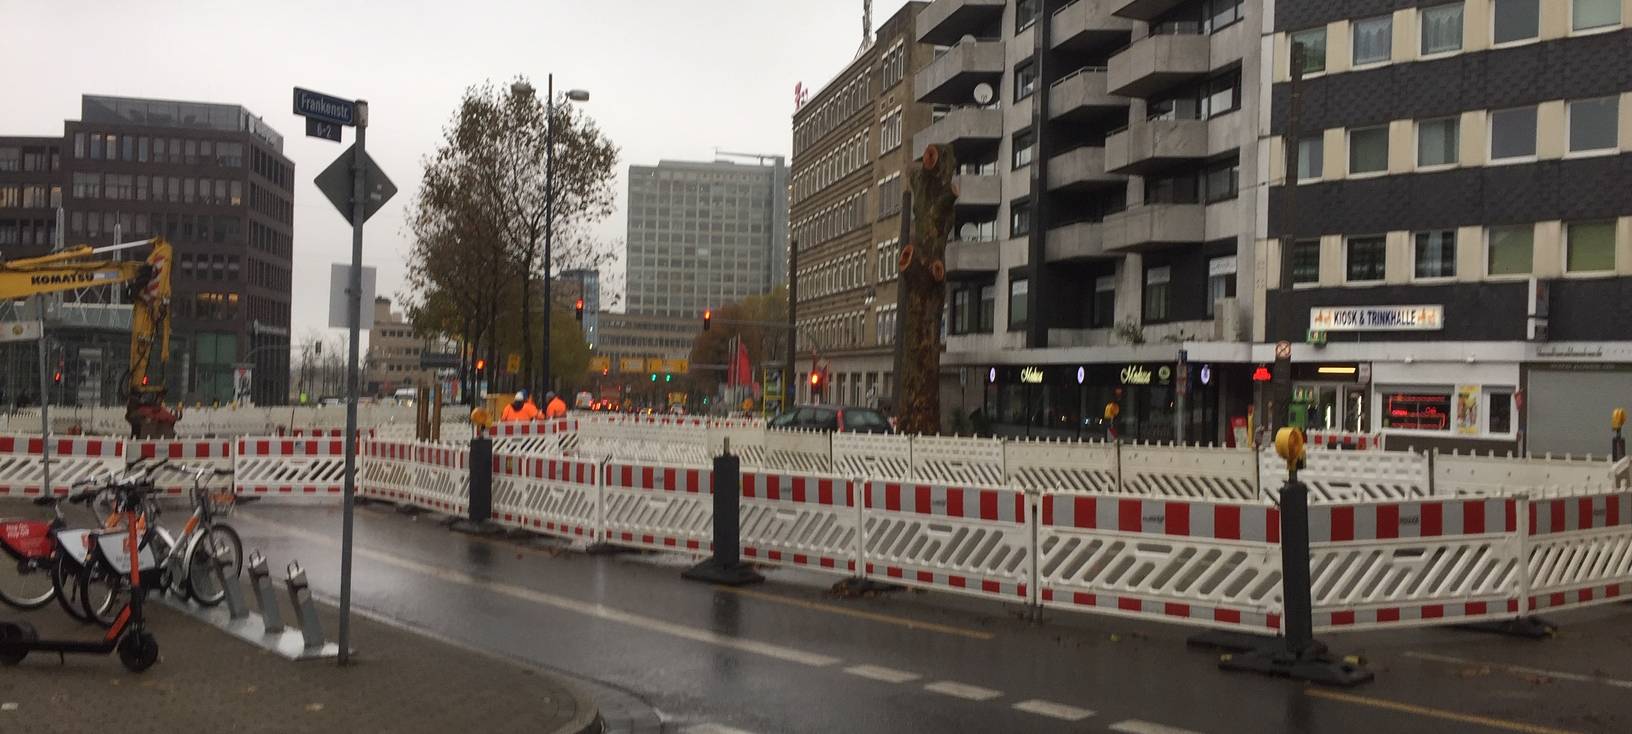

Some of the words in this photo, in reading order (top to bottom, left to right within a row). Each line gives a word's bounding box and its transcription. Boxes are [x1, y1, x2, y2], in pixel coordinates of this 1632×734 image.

[301, 91, 350, 119] Frankenstr.
[31, 271, 94, 286] KOMATSU
[1333, 310, 1358, 325] KIOSK
[1359, 310, 1365, 325] &
[1367, 309, 1417, 326] TRINKHALLE
